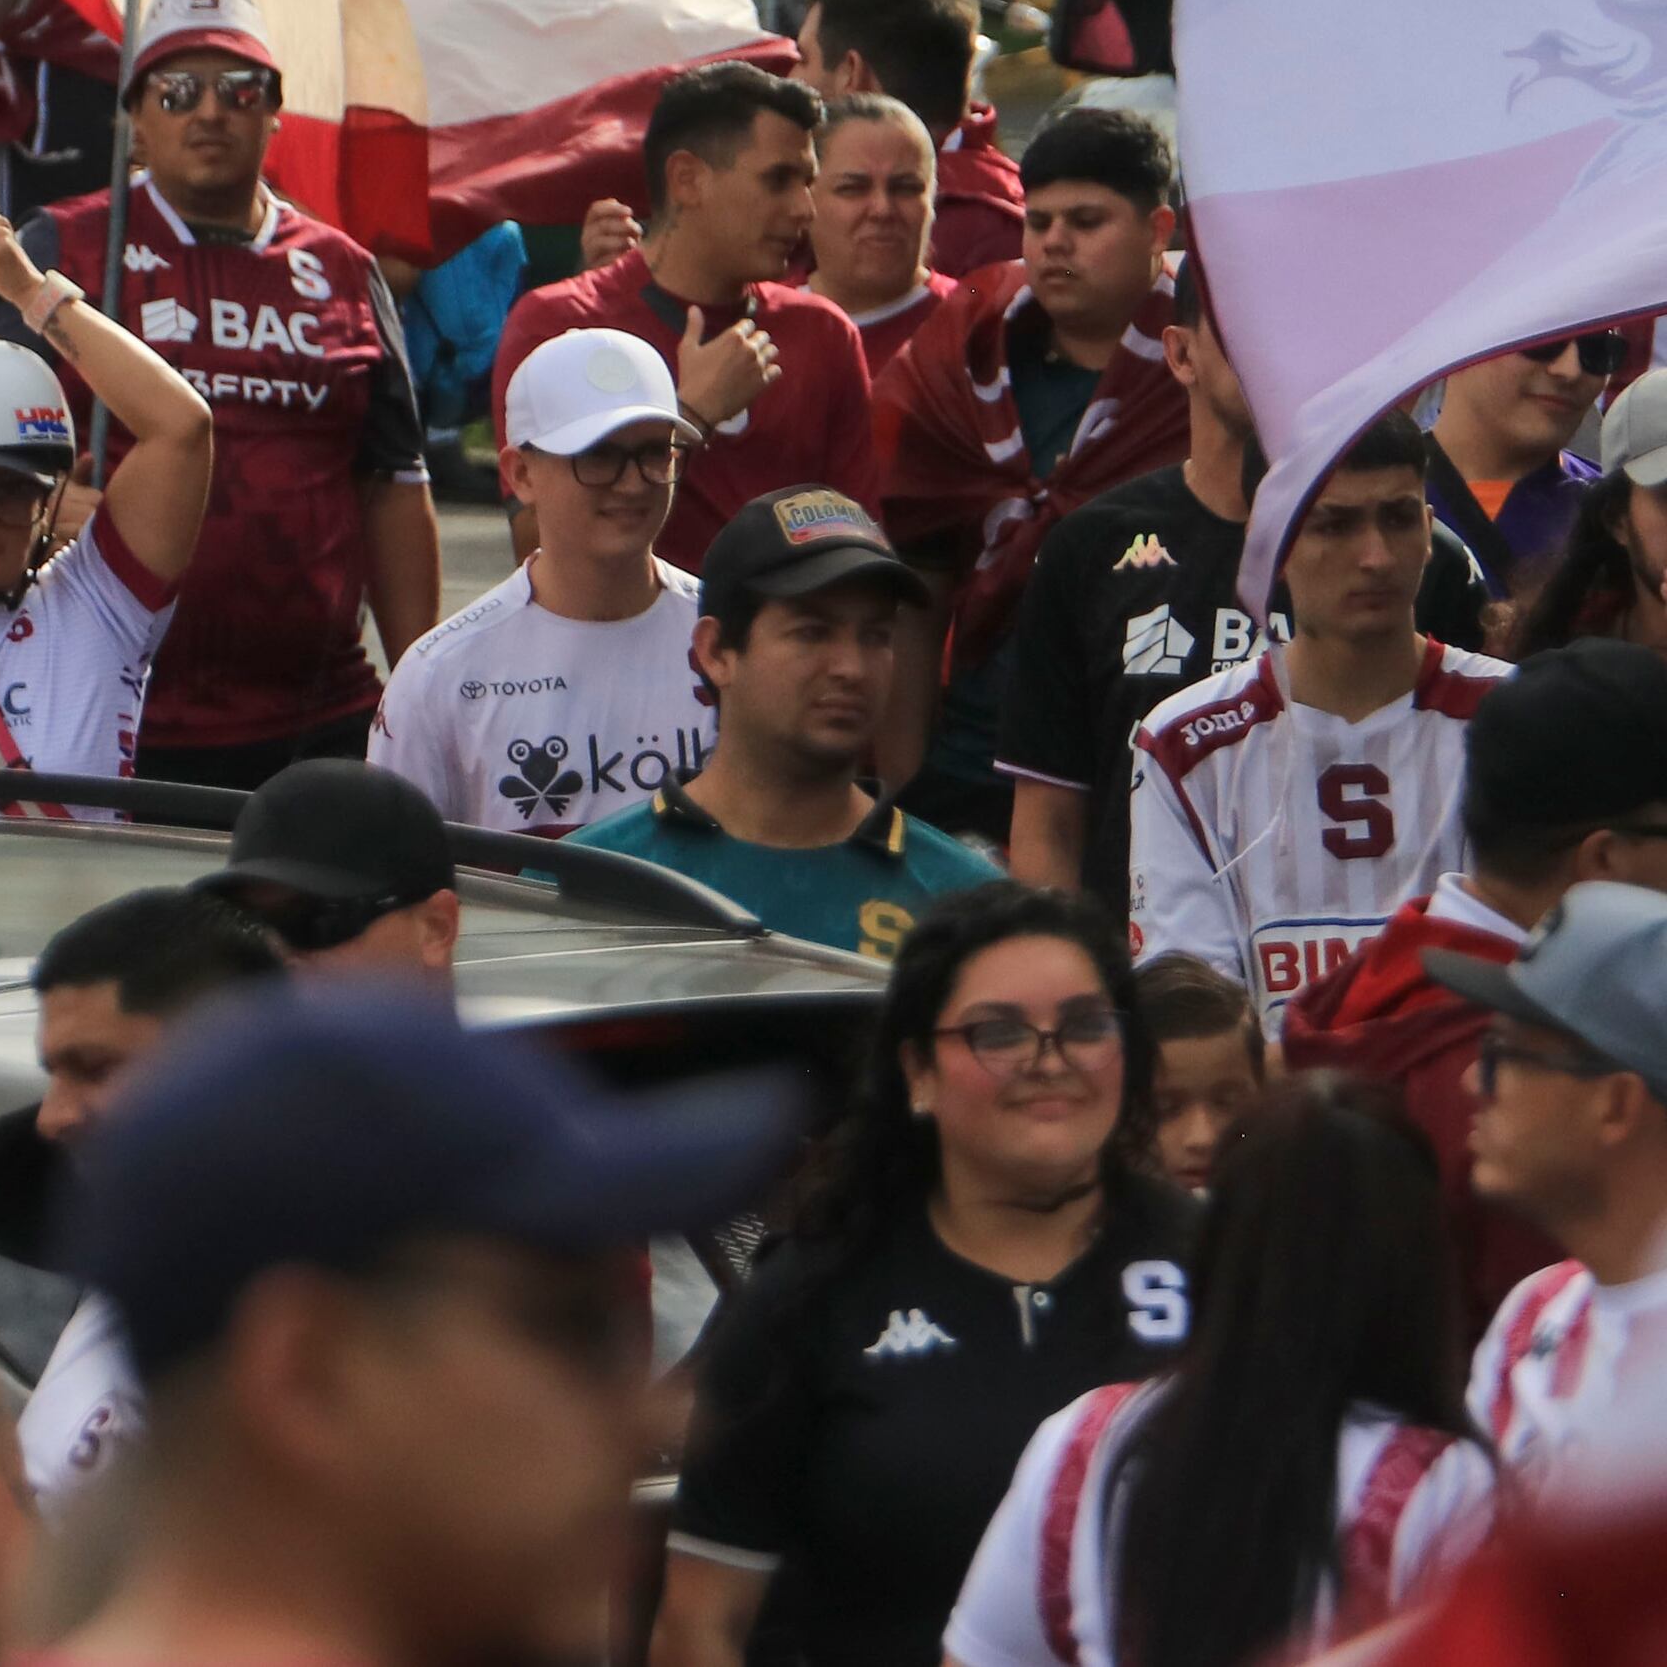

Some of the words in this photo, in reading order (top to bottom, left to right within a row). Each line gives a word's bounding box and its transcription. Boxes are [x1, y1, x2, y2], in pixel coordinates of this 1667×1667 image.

[288, 247, 332, 301] S
[210, 297, 325, 358] BAC
[14, 406, 69, 434] HRC
[490, 676, 568, 697] TOYOTA
[1316, 763, 1395, 860] S
[1121, 1258, 1186, 1339] S
